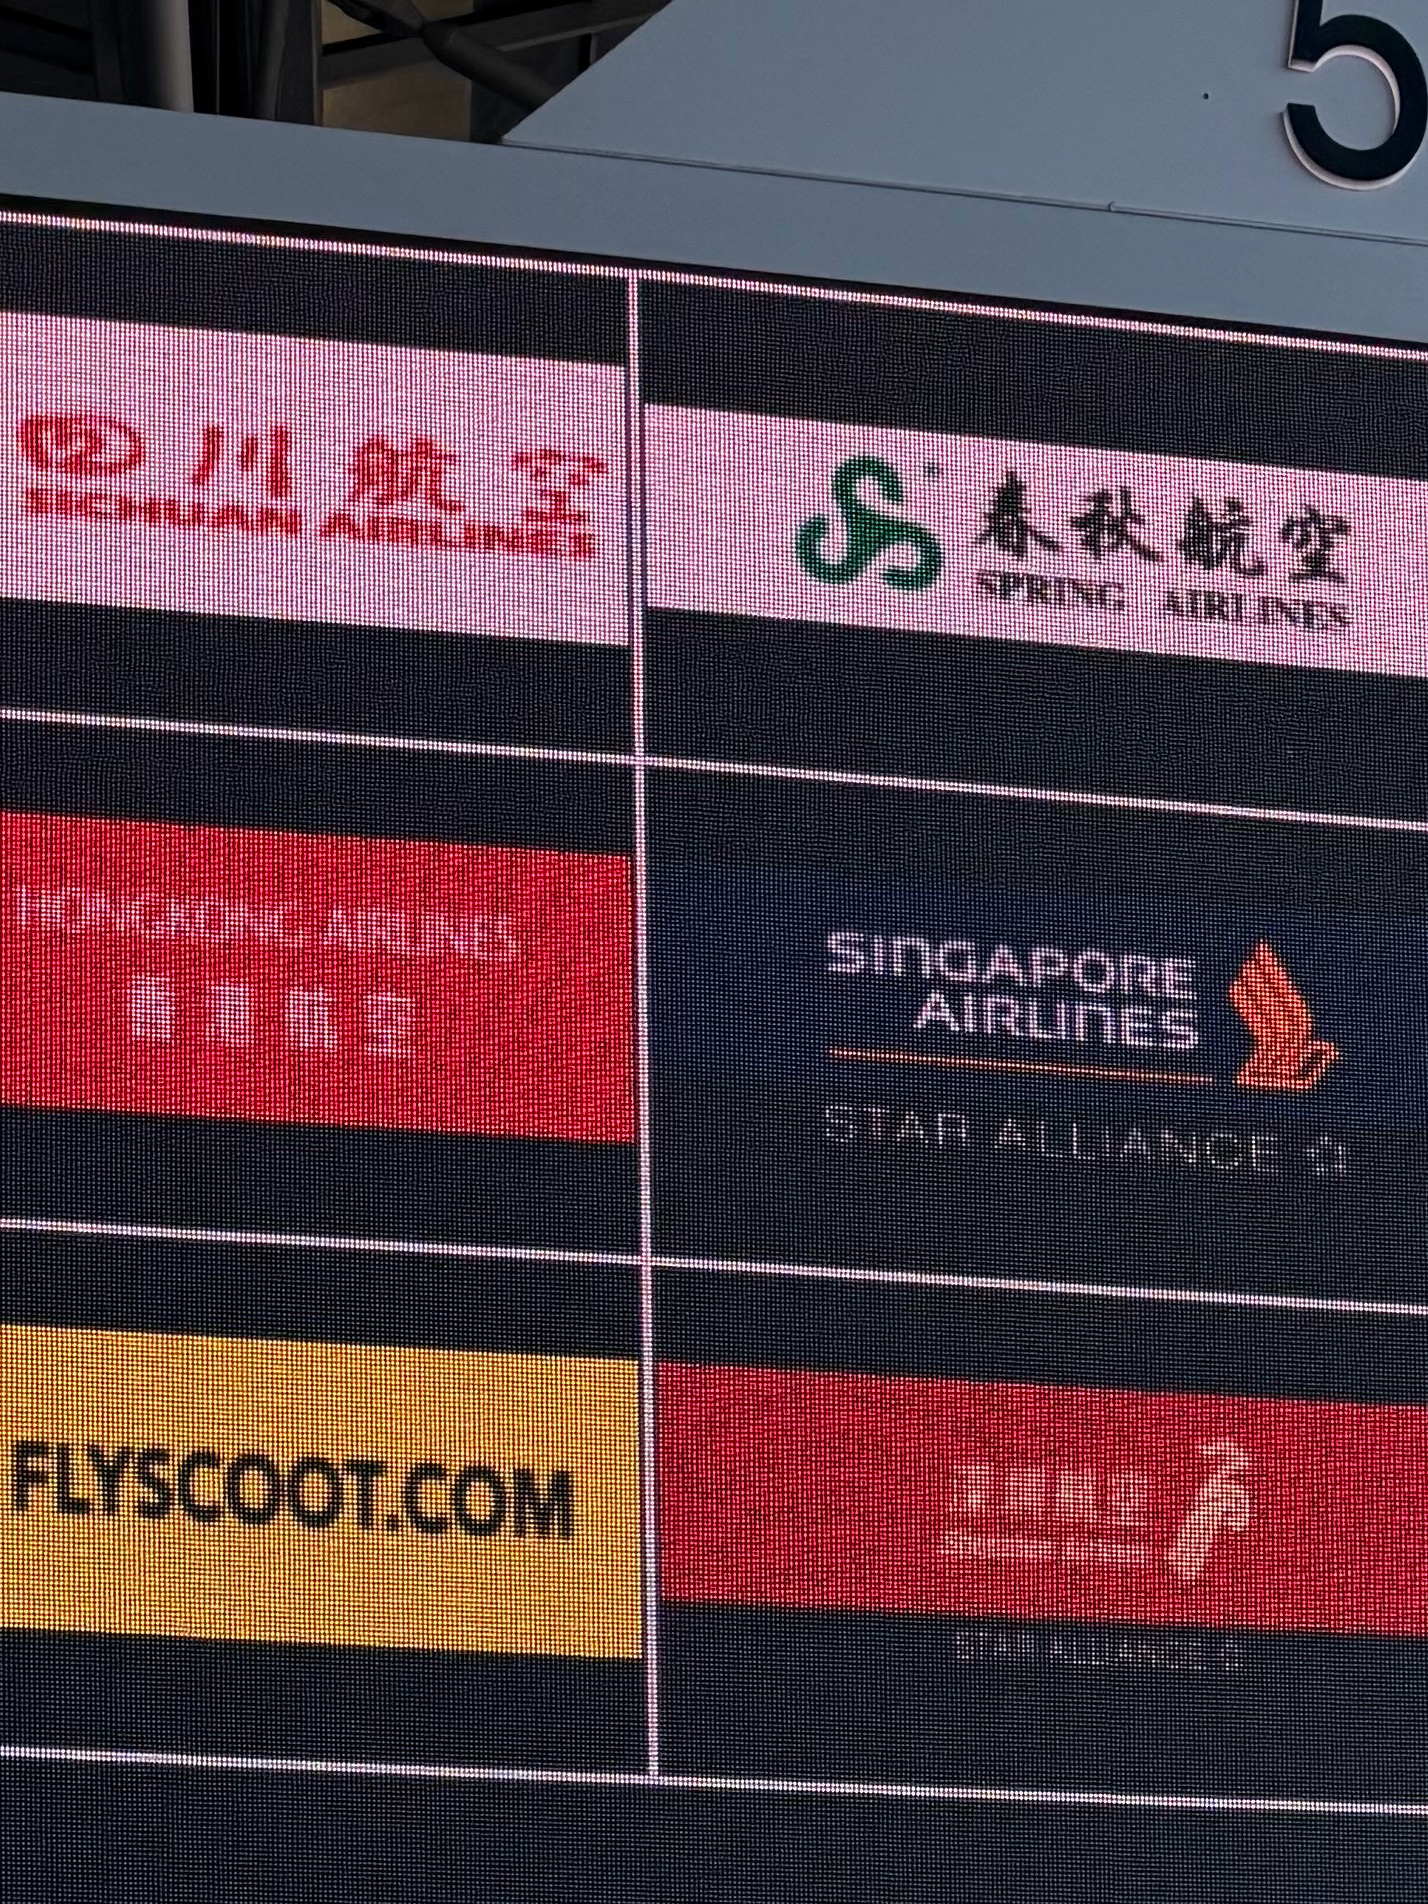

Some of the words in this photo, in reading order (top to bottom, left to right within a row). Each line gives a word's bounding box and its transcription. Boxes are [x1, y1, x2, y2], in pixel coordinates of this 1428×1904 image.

[1281, 0, 1428, 190] 5
[24, 487, 301, 538] SICHUAN
[320, 512, 595, 559] AIRLINES
[976, 469, 1351, 584] 春秋航空
[973, 569, 1116, 612] SPRING
[1167, 588, 1351, 630] AIRLINES
[13, 883, 306, 949] HONGKONG
[323, 907, 520, 962] AIRLINES
[825, 931, 1198, 1000] SINGAPORE
[913, 991, 1200, 1050] AIRLINES
[825, 1104, 969, 1147] STAR
[993, 1117, 1278, 1174] ALLIANCE
[12, 1441, 572, 1539] FLYSCOOT.COM
